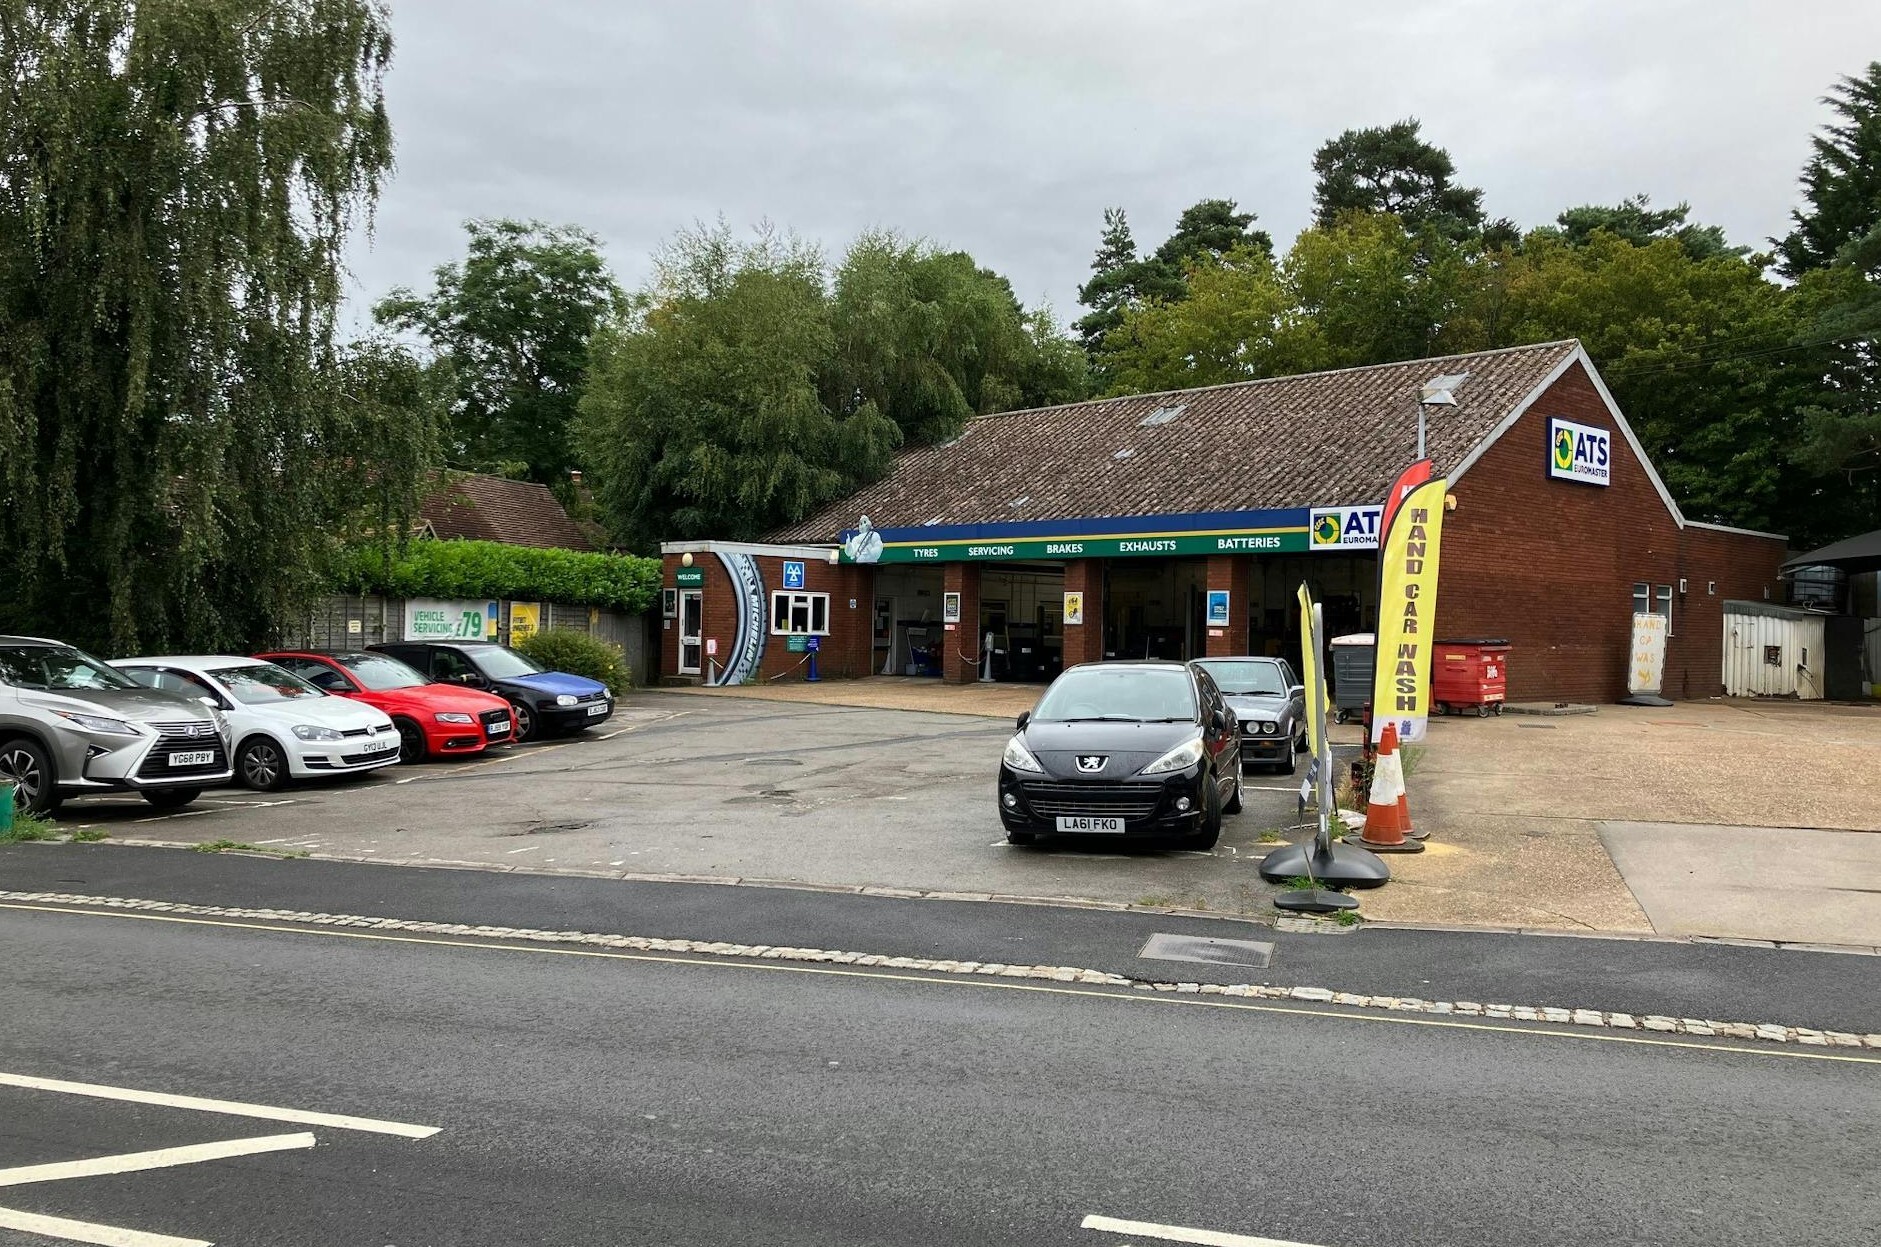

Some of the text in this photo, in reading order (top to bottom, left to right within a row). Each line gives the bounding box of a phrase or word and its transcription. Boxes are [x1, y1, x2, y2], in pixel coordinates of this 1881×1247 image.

[1575, 433, 1607, 466] ATS
[1575, 465, 1607, 478] EUROMASTER
[1343, 511, 1380, 535] AT
[913, 537, 1280, 558] TYRES SERVICING BRAKES EXHAUSTS BATTERIES
[1343, 536, 1379, 544] EUROMA
[1405, 508, 1428, 574] HAND
[1403, 584, 1420, 634] CAR
[413, 622, 452, 633] SERVICING
[414, 611, 482, 637] VEHICLE £79
[745, 594, 759, 662] MICHELIN
[1395, 644, 1417, 711] WASH
[173, 752, 211, 763] YG68 PBY
[1064, 818, 1117, 830] LA61 FKO
